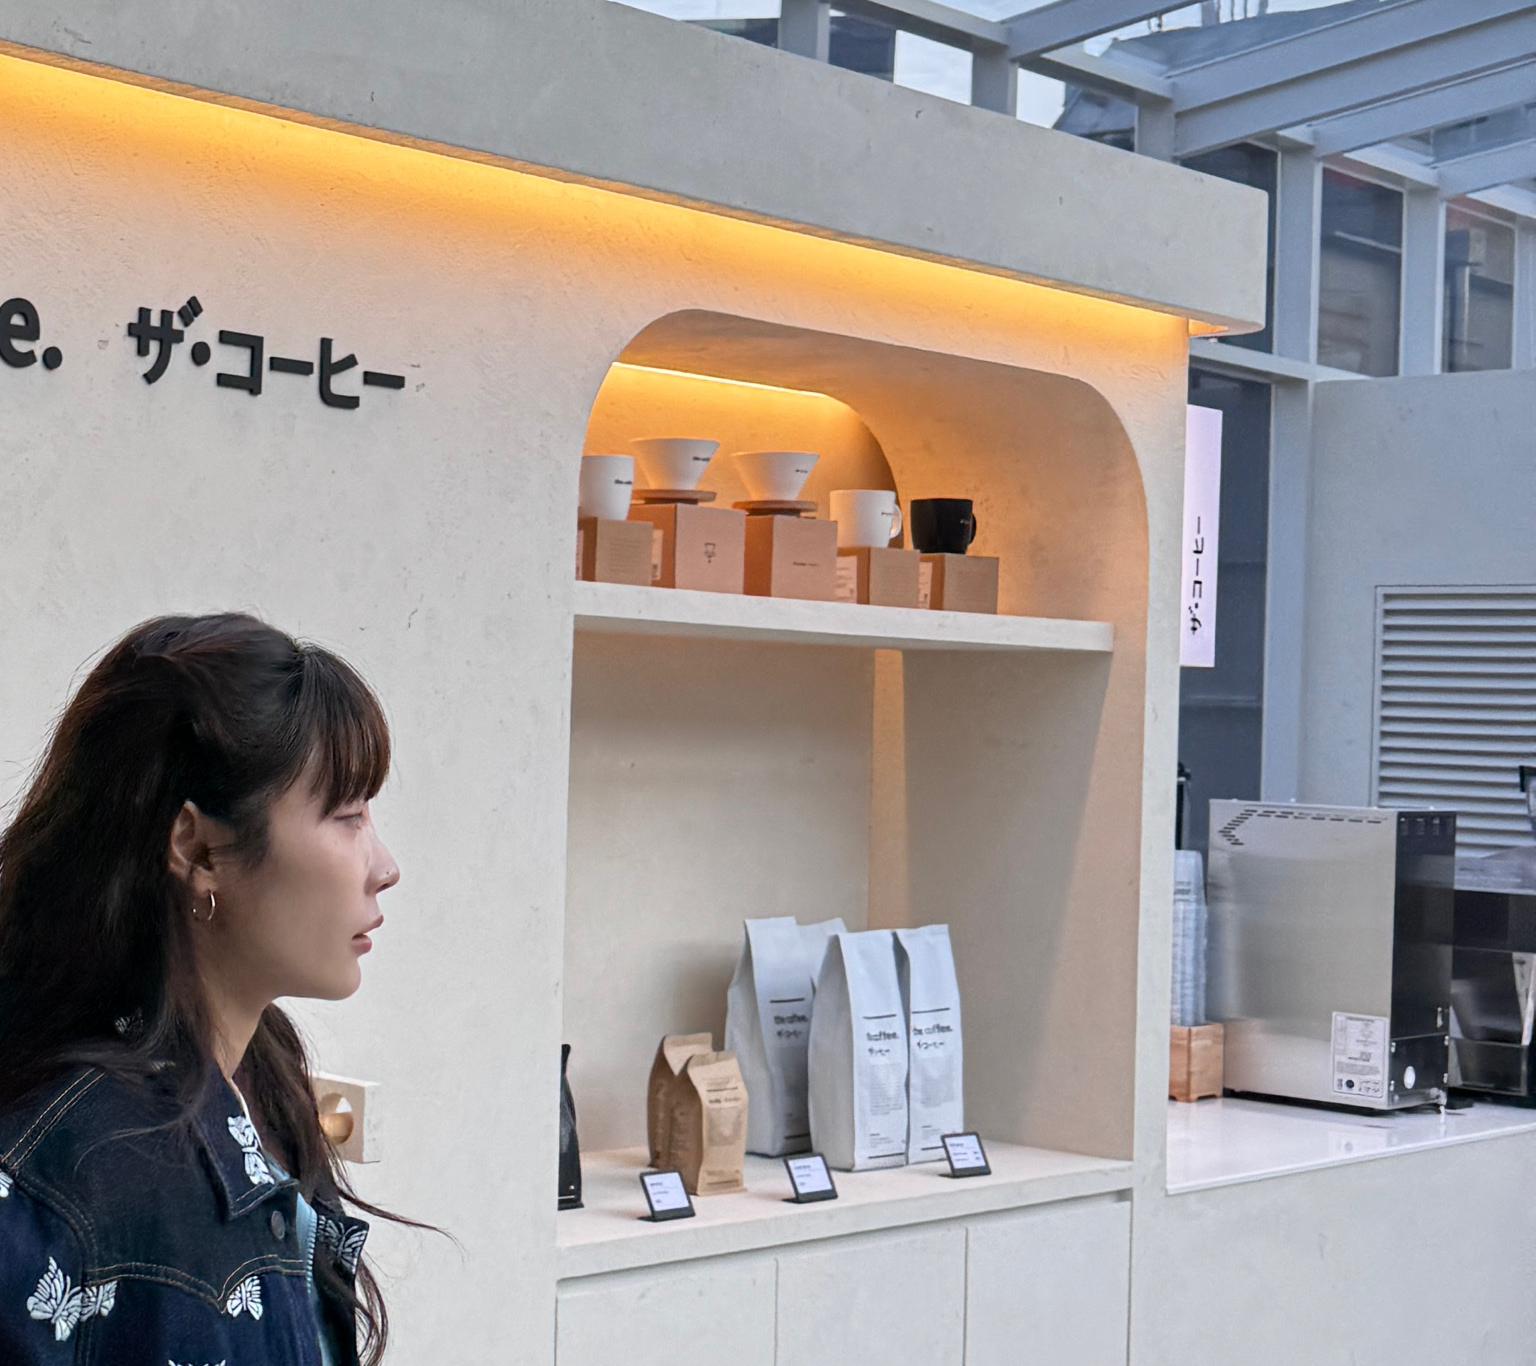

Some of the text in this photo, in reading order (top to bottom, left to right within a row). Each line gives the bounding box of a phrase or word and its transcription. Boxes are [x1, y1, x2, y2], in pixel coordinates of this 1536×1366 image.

[127, 295, 406, 410] ザ・コーヒー
